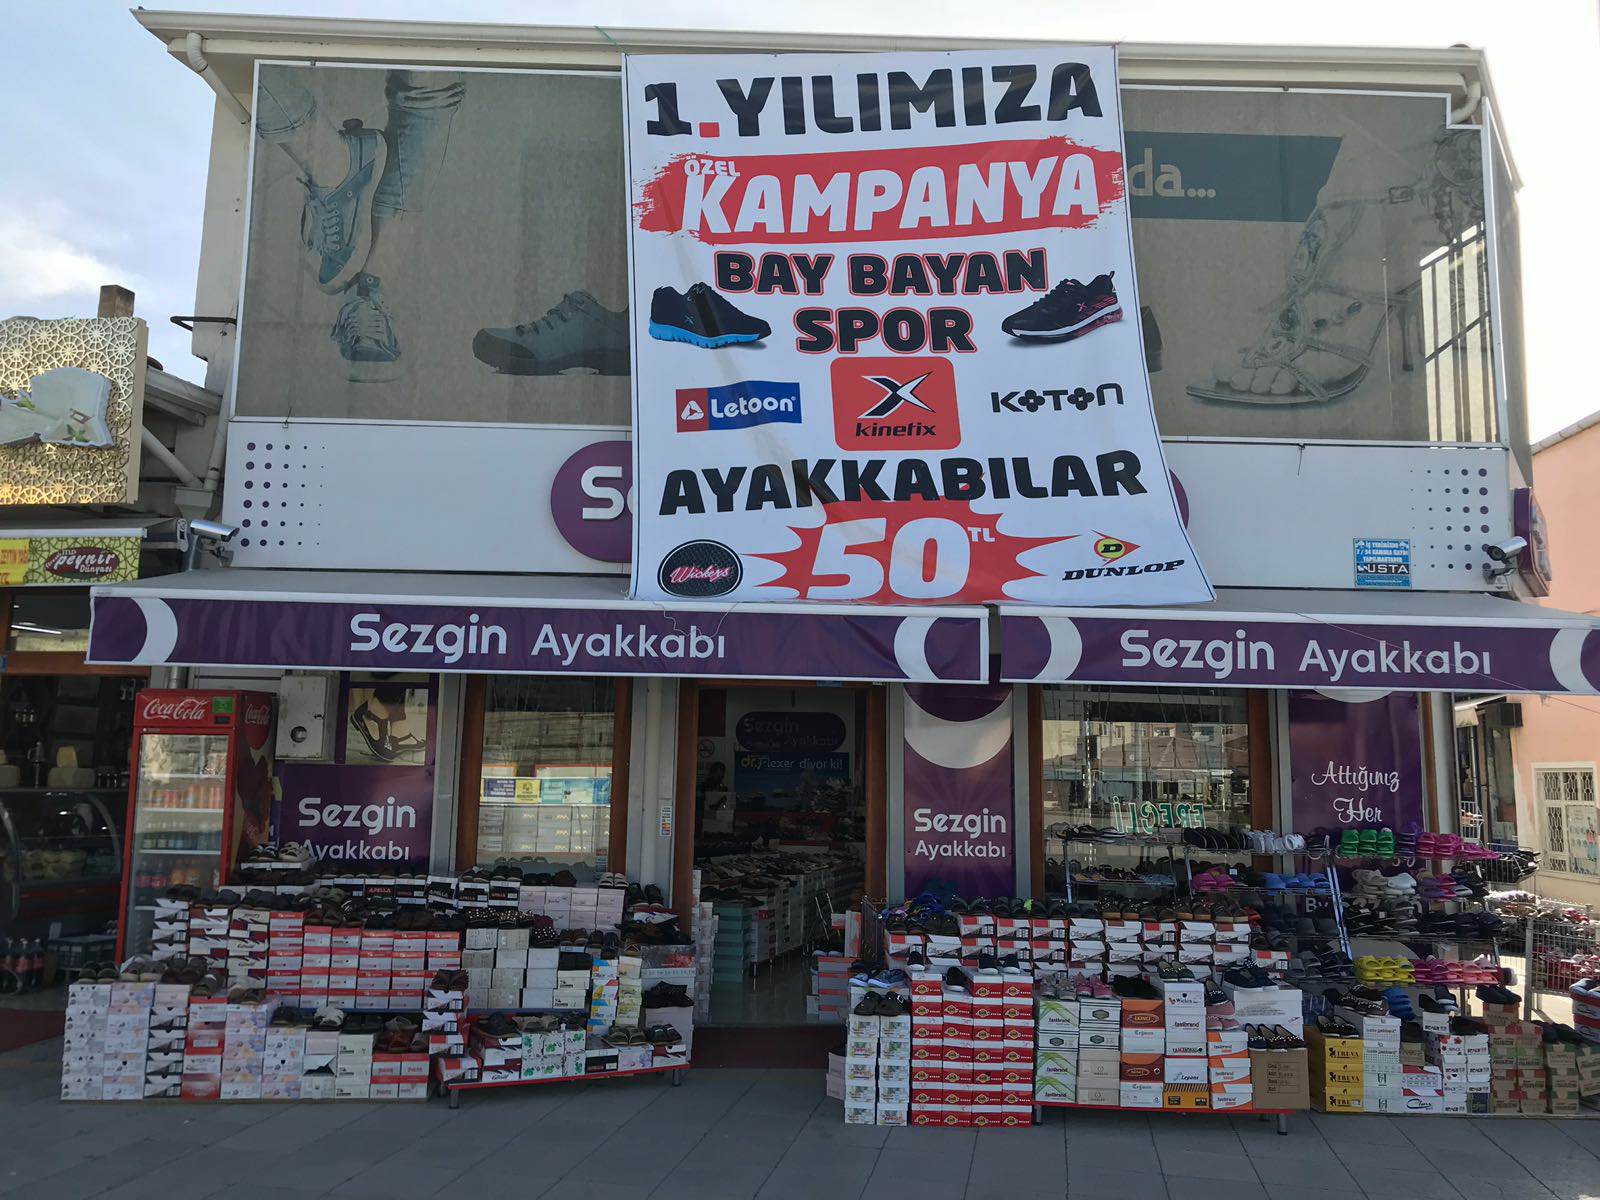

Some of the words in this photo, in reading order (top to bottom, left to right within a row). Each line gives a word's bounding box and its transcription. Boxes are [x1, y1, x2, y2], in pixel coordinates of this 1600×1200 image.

[684, 154, 740, 177] ÖZEL
[681, 153, 1100, 234] KAMPANYA
[714, 249, 834, 295] BAY
[848, 247, 1047, 296] BAYAN
[795, 305, 977, 354] SPOR
[710, 394, 796, 420] Letoon
[855, 421, 938, 438] kinetix
[658, 448, 1149, 516] AYAKKABILAR
[967, 525, 996, 543] TL
[806, 516, 971, 601] 50
[1061, 559, 1185, 581] DUNLOP
[1367, 564, 1409, 574] USTA
[350, 612, 508, 664] Sezgin
[531, 624, 726, 666] Ayakkabı
[1121, 629, 1276, 680] Sezgin
[1298, 639, 1492, 682] Ayakkabı
[1310, 759, 1400, 792] Attığınız
[299, 796, 417, 836] Sezgin
[913, 807, 1007, 838] Sezgin
[1332, 797, 1383, 824] Her
[300, 839, 410, 862] Ayakkabı
[914, 839, 1006, 861] Ayakkabı
